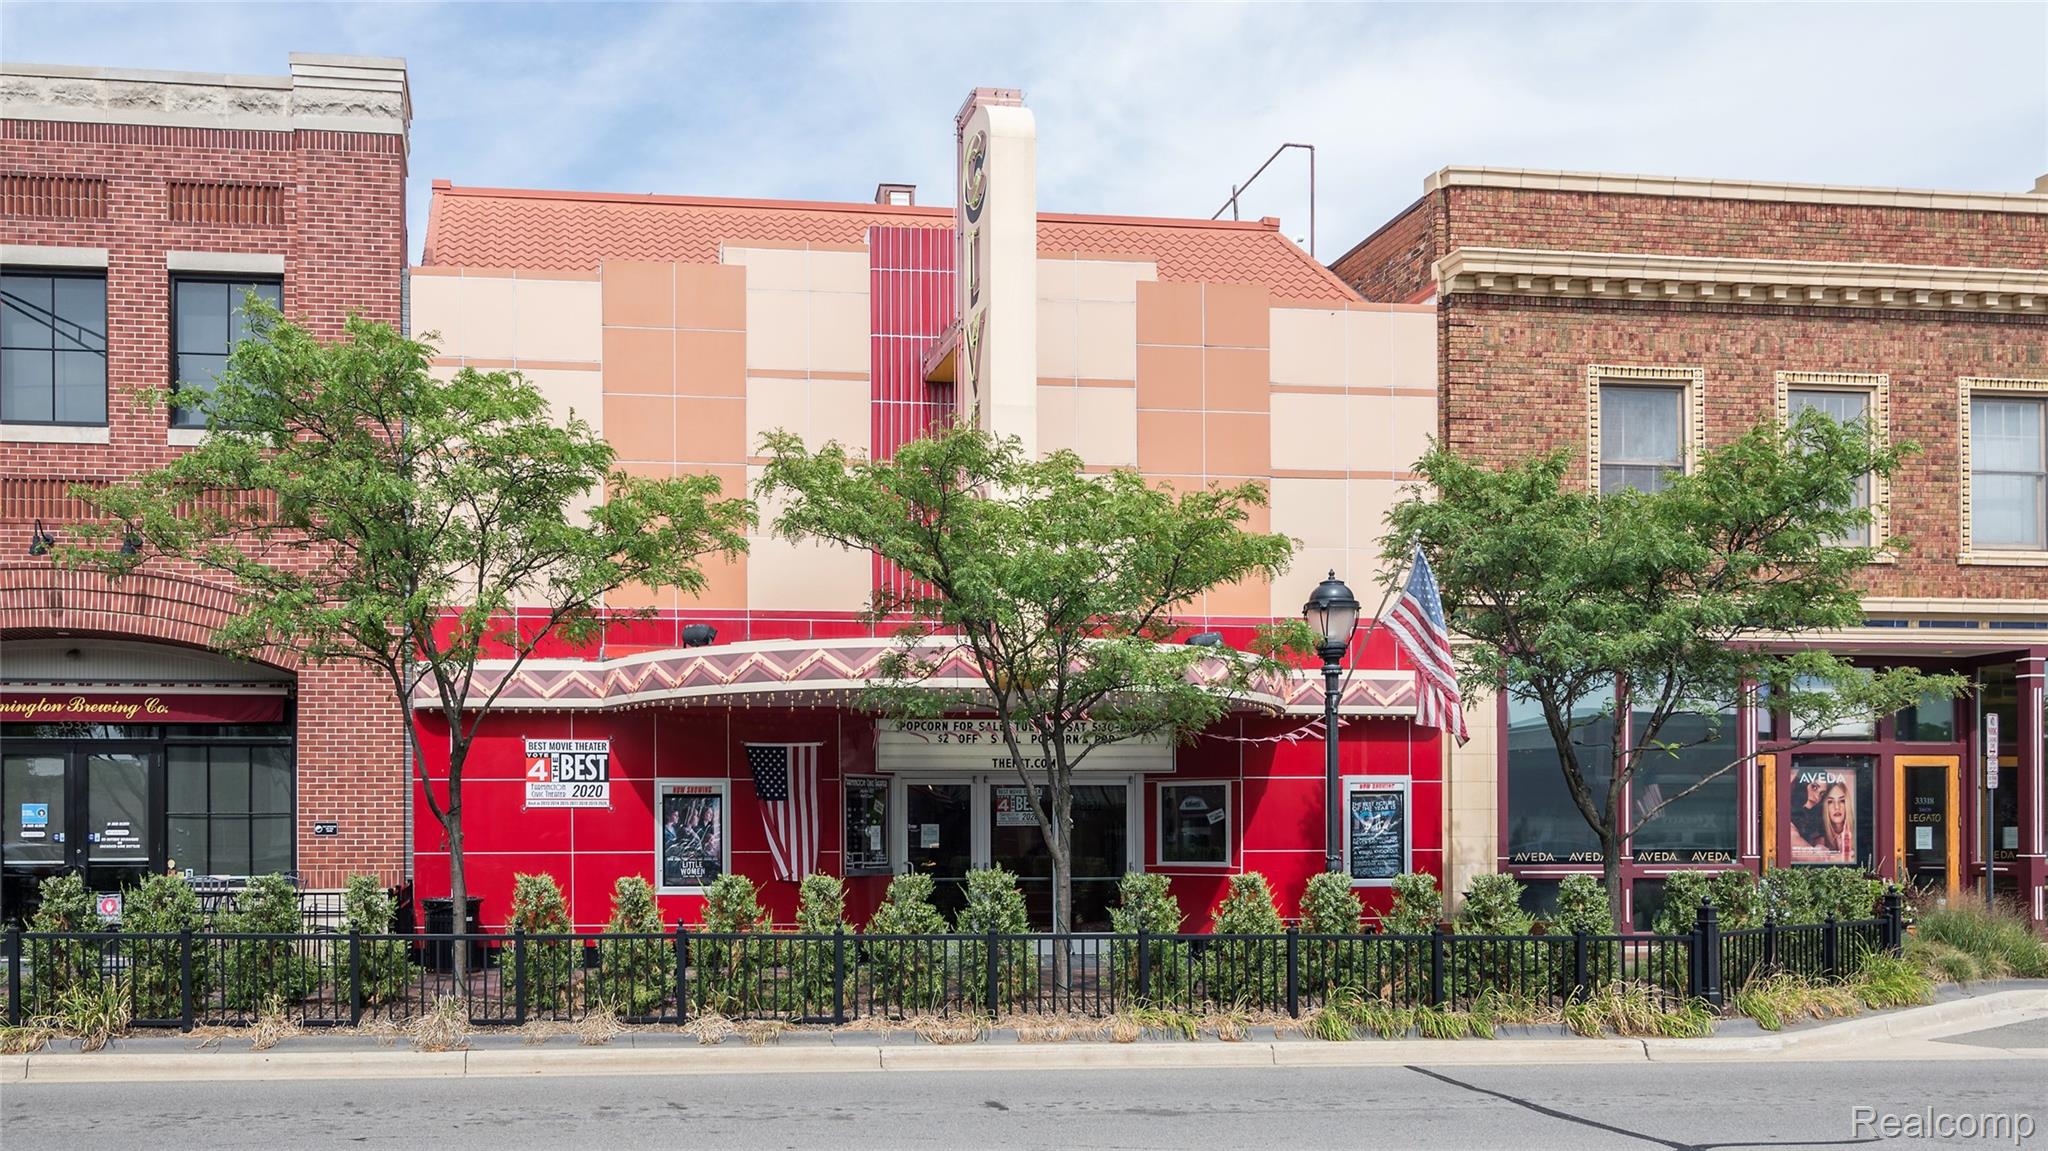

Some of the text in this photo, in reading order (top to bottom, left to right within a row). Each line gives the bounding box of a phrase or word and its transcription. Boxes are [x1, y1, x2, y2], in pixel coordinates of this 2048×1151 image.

[67, 696, 142, 719] Brewing
[145, 697, 169, 714] Co.
[899, 721, 949, 731] POPCORN
[953, 721, 974, 731] FOR
[1068, 721, 1086, 732] SAT
[937, 734, 949, 744] $2
[958, 734, 978, 744] OFF
[1031, 734, 1079, 744] POPRN
[528, 741, 607, 751] BEST MOVIE THEATER
[527, 759, 549, 781] 4
[560, 753, 608, 781] BEST
[991, 758, 1056, 769] THEFT.COM
[1799, 772, 1847, 784] AVEDA
[572, 784, 603, 798] 2020
[1908, 813, 1942, 822] LEGATO
[1514, 852, 1554, 862] AVEDA
[1569, 852, 1604, 862] AVED
[1638, 852, 1678, 862] AVEDA
[1691, 851, 1731, 862] AVEDA
[682, 860, 703, 868] LITTLE
[680, 868, 705, 876] WOMEN
